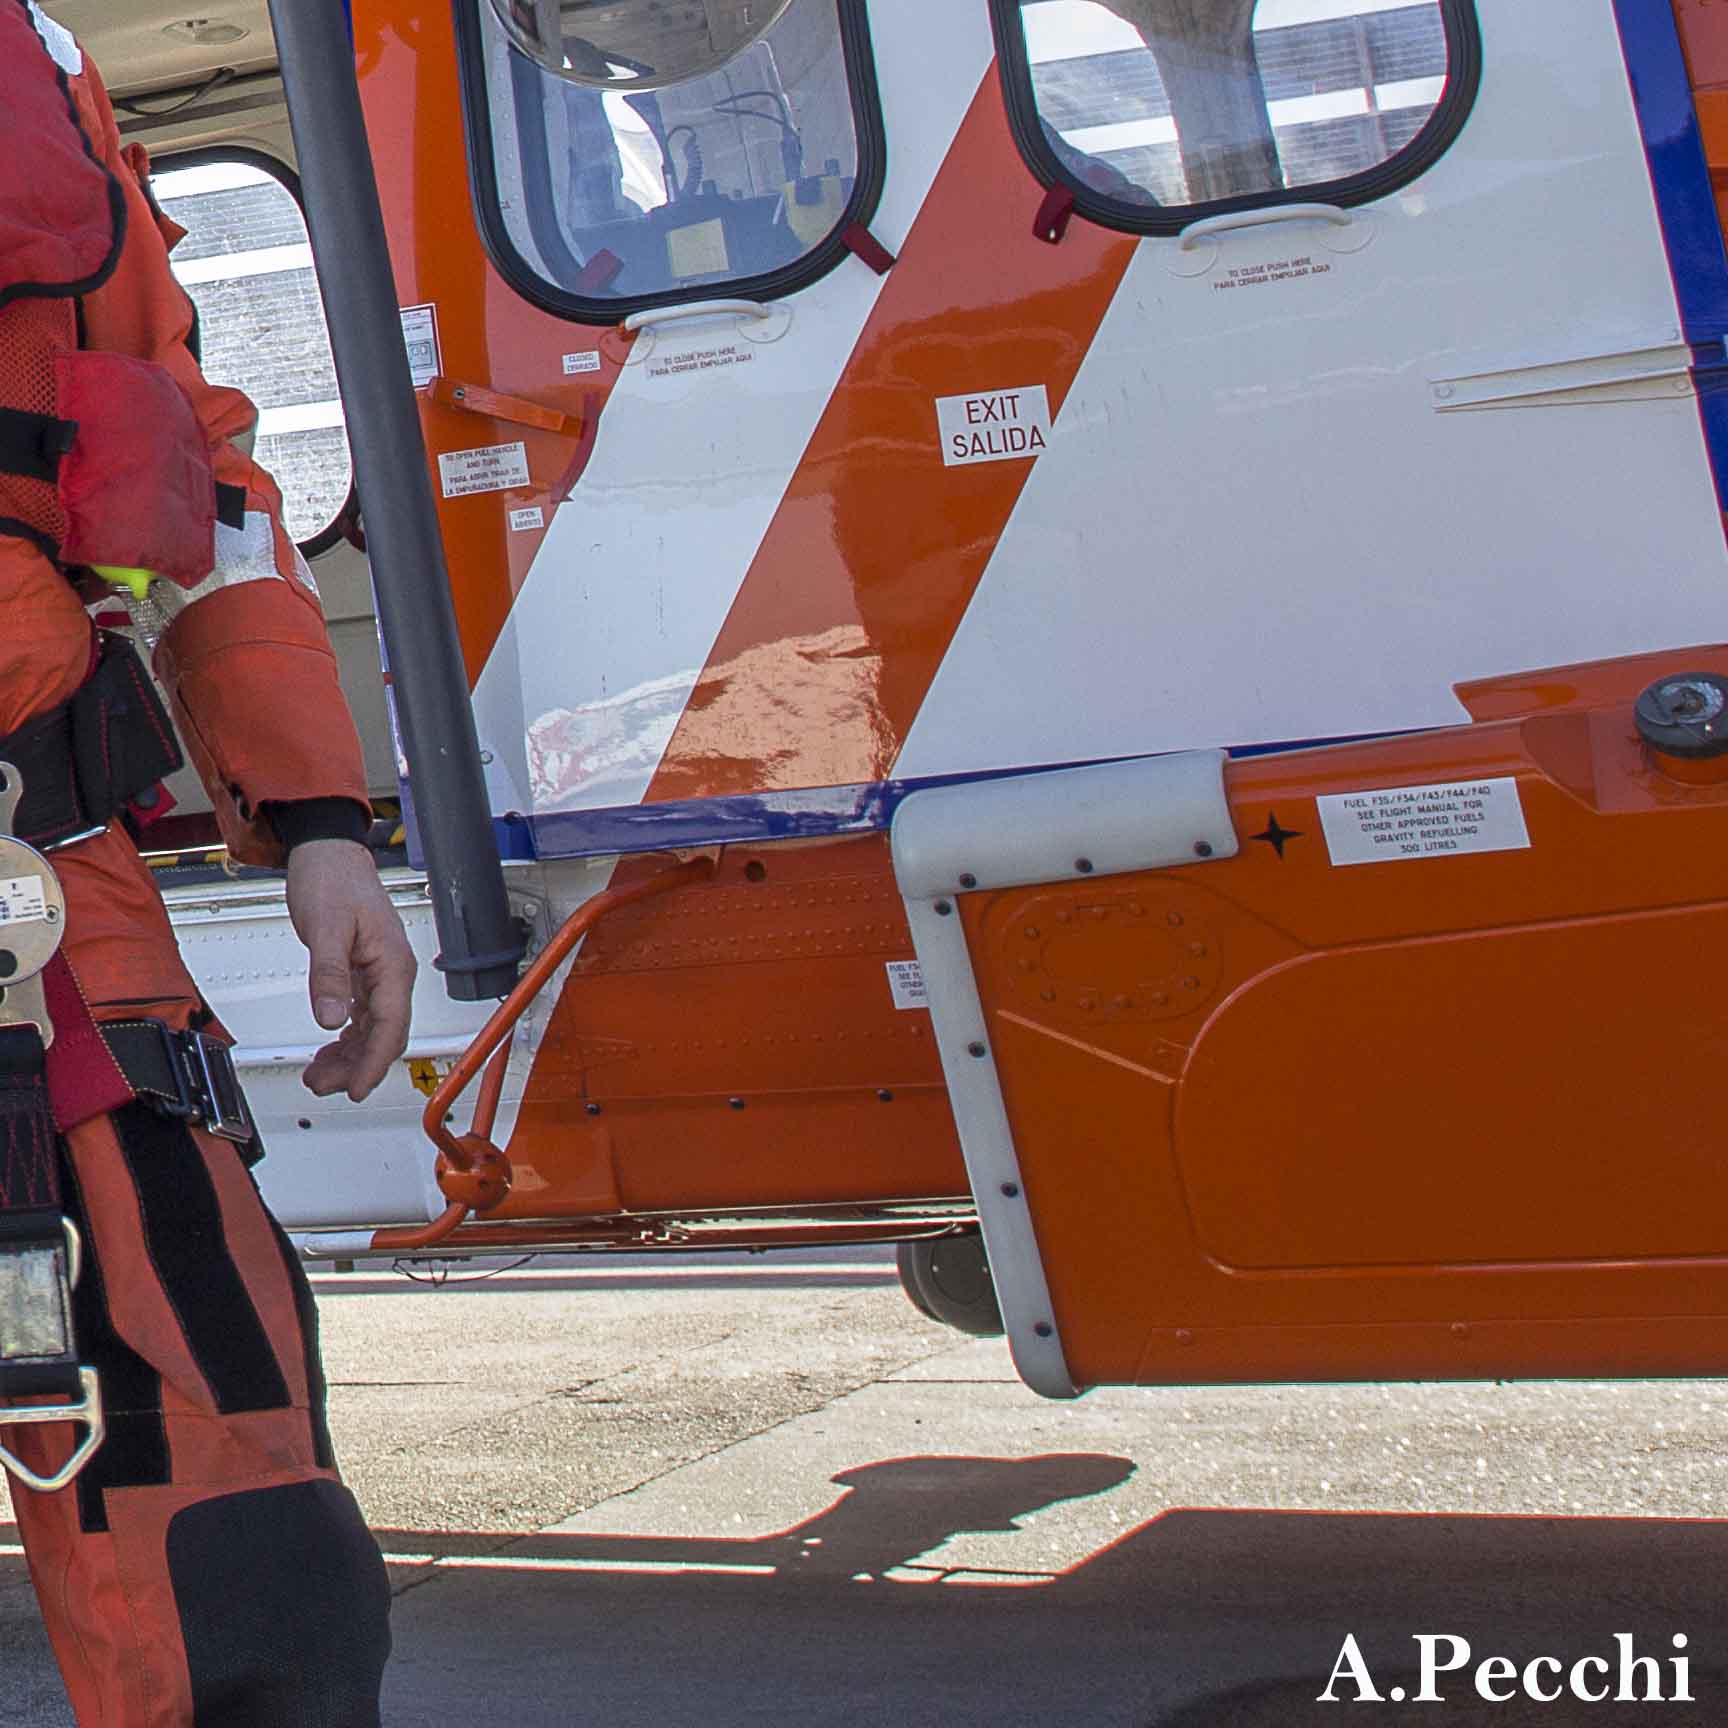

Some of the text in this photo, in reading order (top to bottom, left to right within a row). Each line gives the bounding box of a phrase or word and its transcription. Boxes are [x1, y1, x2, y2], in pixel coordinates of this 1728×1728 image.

[965, 394, 1020, 424] EXIT
[952, 425, 1046, 458] SALIDA
[1343, 798, 1368, 809] FUEL
[1357, 799, 1483, 820] SEE FLIGHT MANUAL FOR
[1360, 812, 1485, 833] OTHER APPROVED FUELS
[1373, 825, 1478, 843] GRAVITY REFUELLING
[1400, 840, 1457, 854] 300 LITRES
